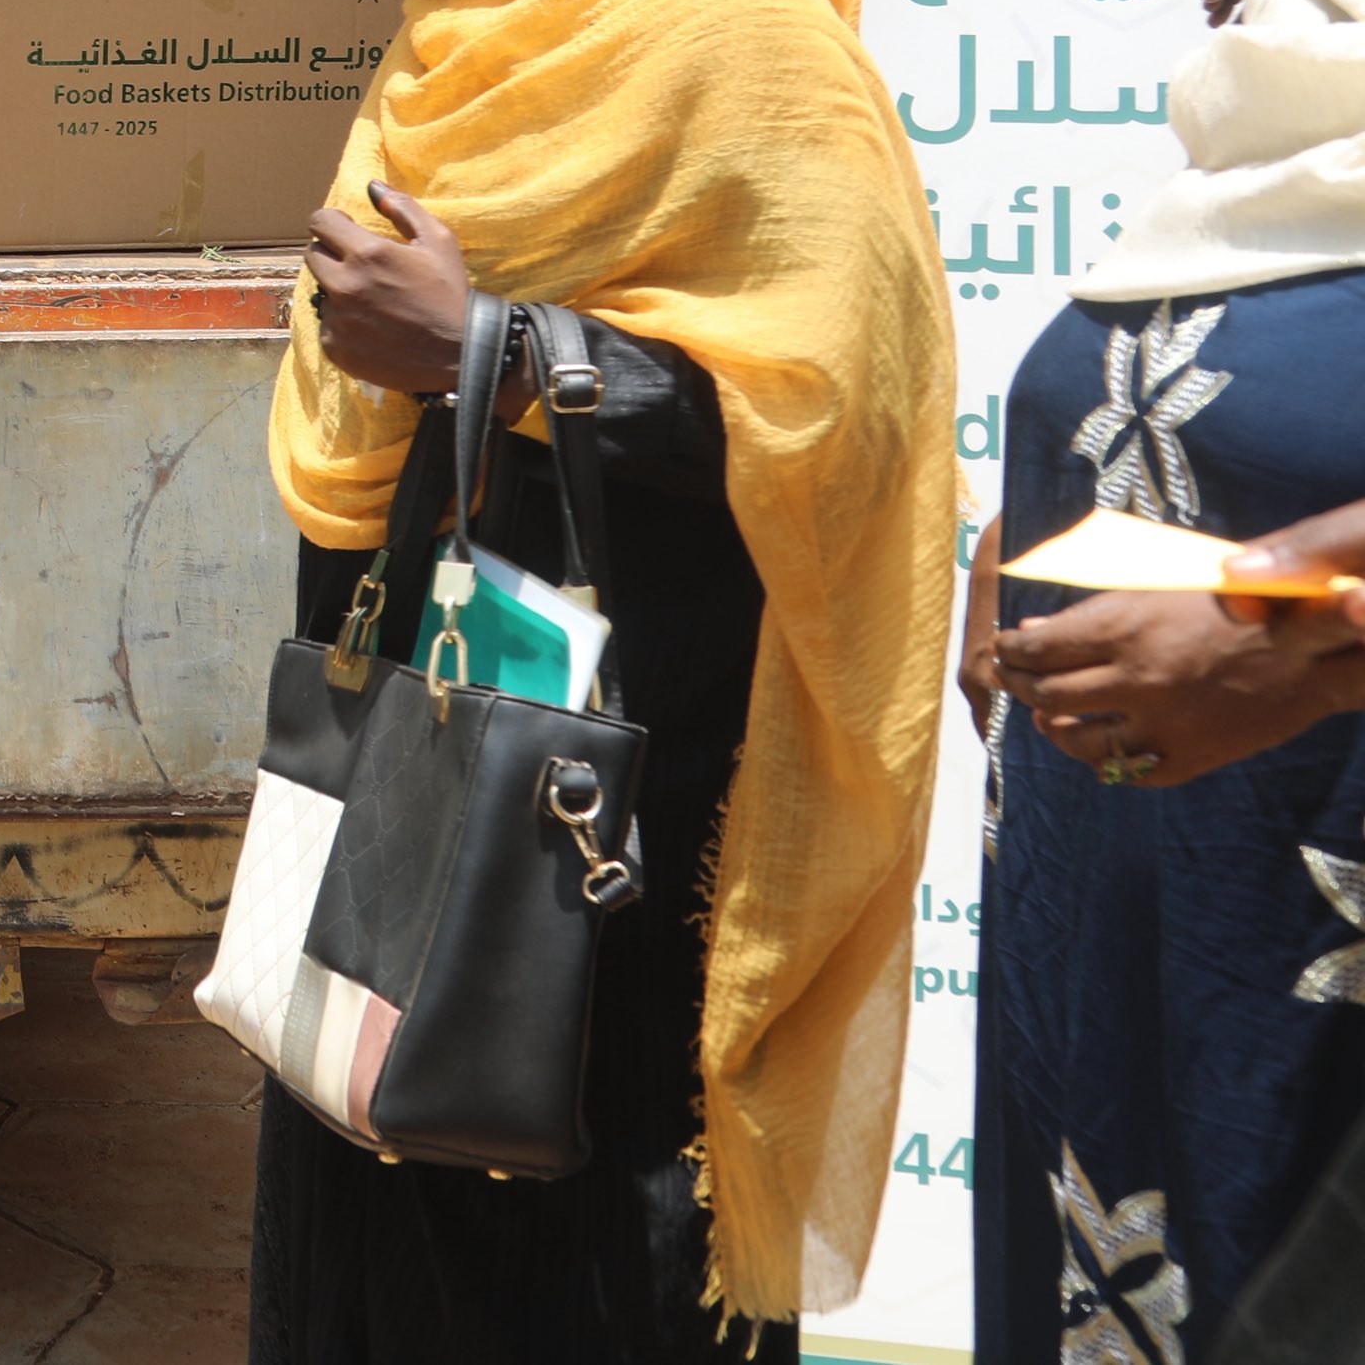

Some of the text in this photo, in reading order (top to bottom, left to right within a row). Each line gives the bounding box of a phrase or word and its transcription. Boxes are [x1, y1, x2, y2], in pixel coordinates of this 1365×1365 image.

[26, 38, 177, 74] الغذائية
[187, 37, 300, 71] السلال
[53, 80, 360, 105] Food Baskets Distribution
[57, 121, 99, 136] 1447
[115, 120, 158, 136] 2025
